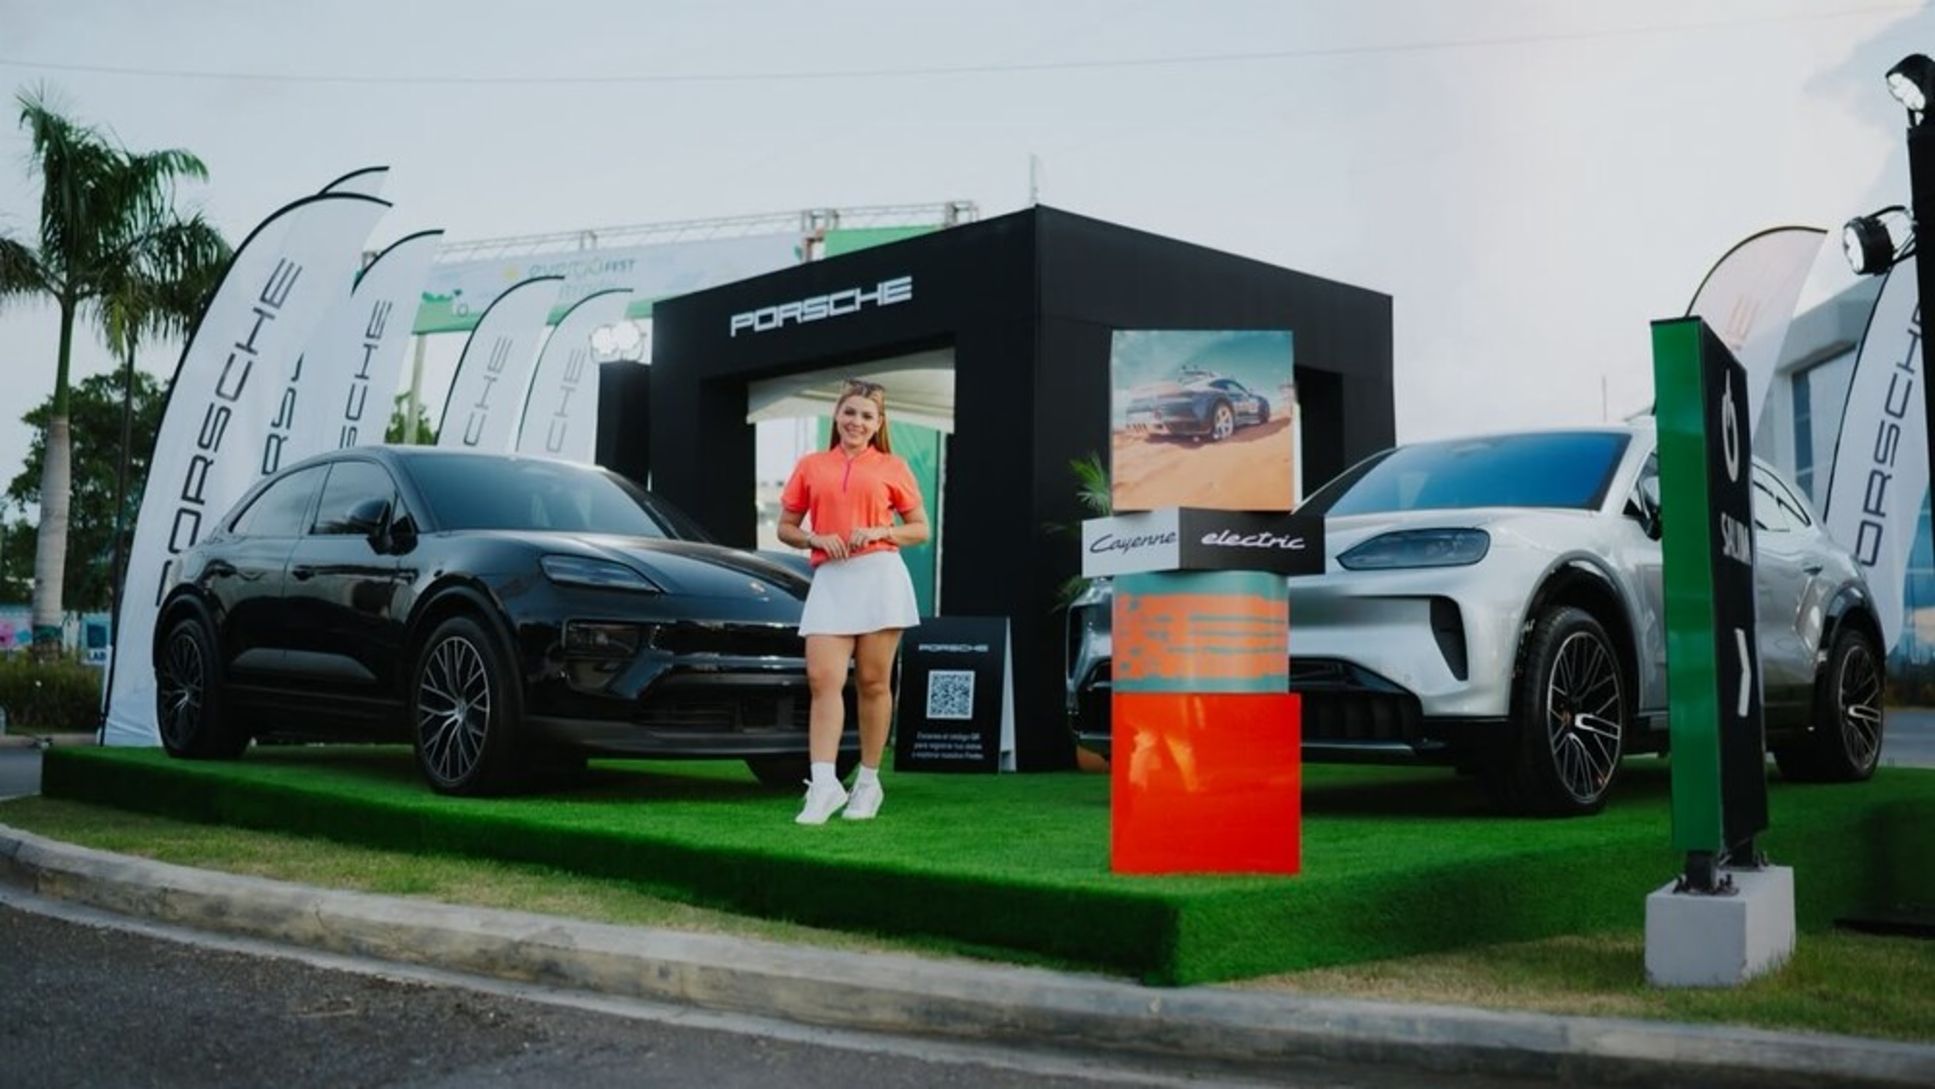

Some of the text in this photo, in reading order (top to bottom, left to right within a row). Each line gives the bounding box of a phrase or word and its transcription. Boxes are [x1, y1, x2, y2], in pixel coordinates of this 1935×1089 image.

[730, 275, 913, 338] PORSCHE
[1089, 529, 1305, 555] Cayenne electric
